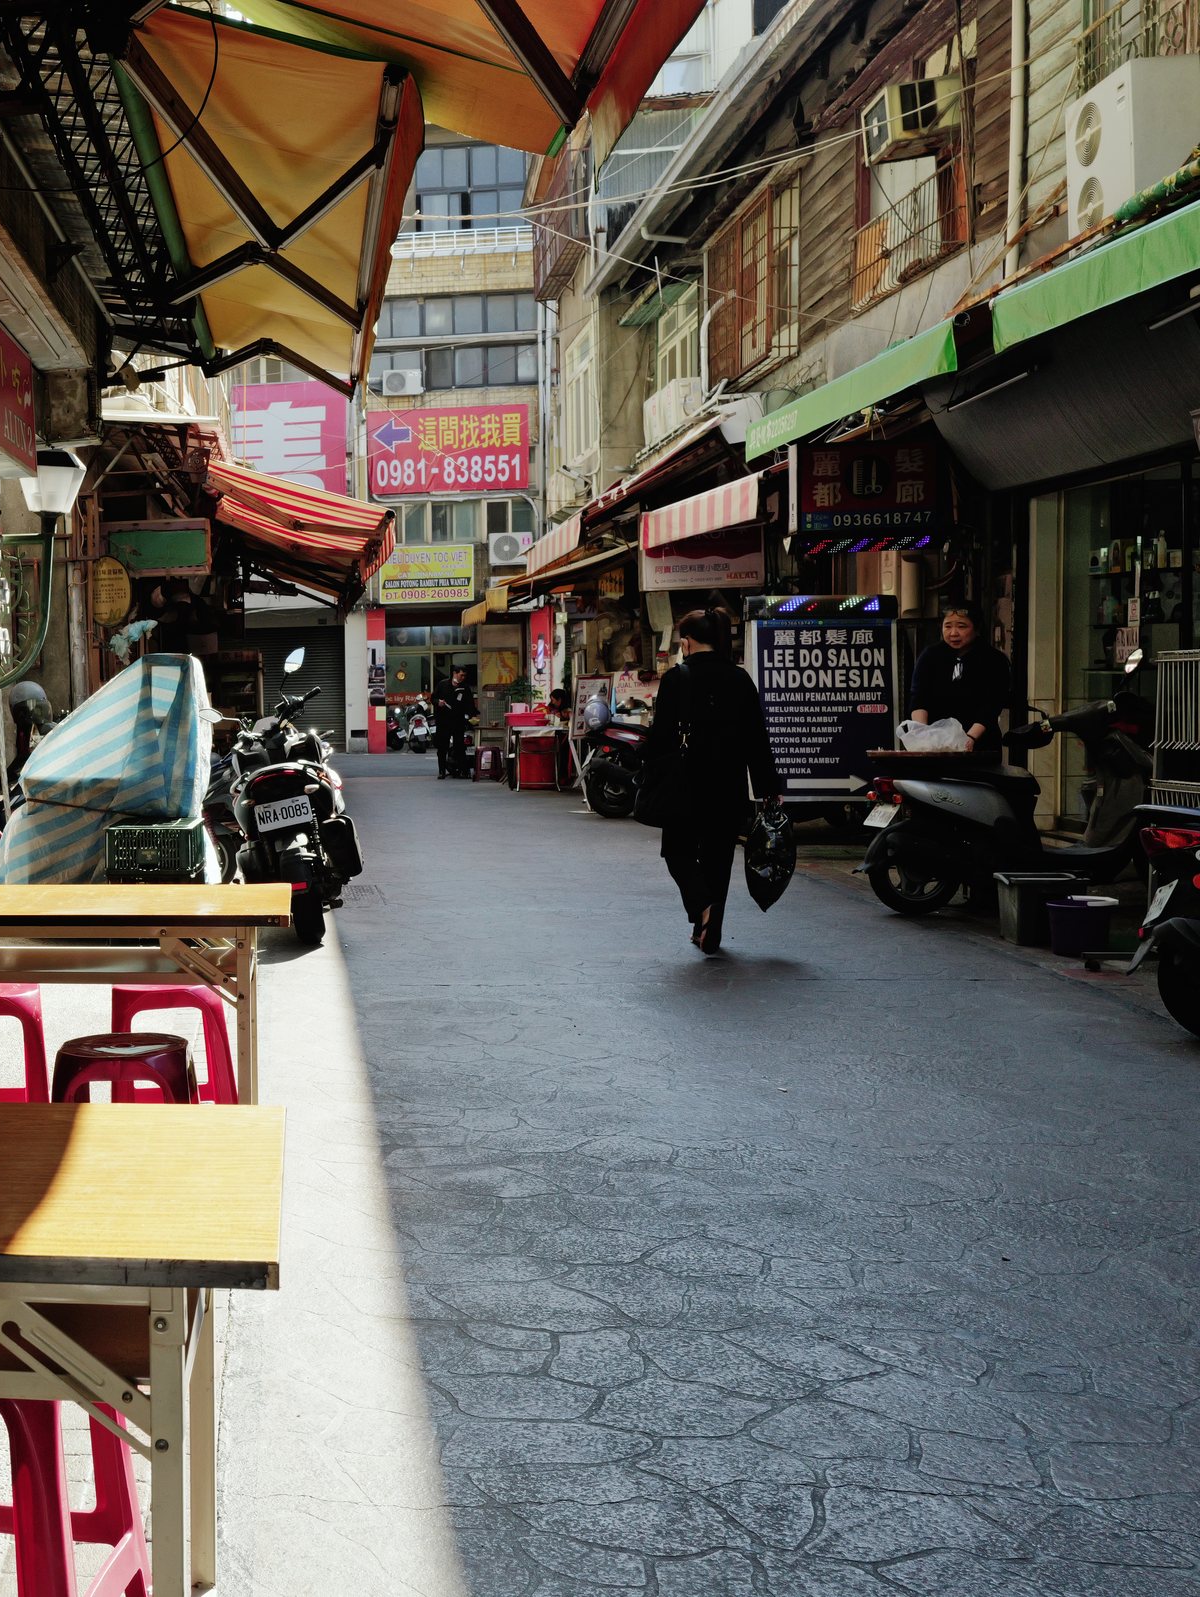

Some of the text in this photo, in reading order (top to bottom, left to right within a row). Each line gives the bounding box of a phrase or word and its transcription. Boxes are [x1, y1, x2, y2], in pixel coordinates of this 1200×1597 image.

[418, 412, 522, 452] 這間找我買
[376, 453, 521, 488] 0981-838551
[833, 511, 931, 528] 0936618747
[401, 589, 470, 599] 0908-260985
[773, 629, 874, 646] 麗都髮廊
[763, 647, 885, 668] LEE DO SALON
[763, 669, 885, 689] INDONESIA
[764, 691, 882, 702] MELAYANI PENATAAN RAMBUT
[821, 705, 853, 713] RAMBUT
[801, 736, 833, 744] RAMBUT
[789, 767, 812, 775] MUKA
[257, 802, 309, 825] NRA-0085
